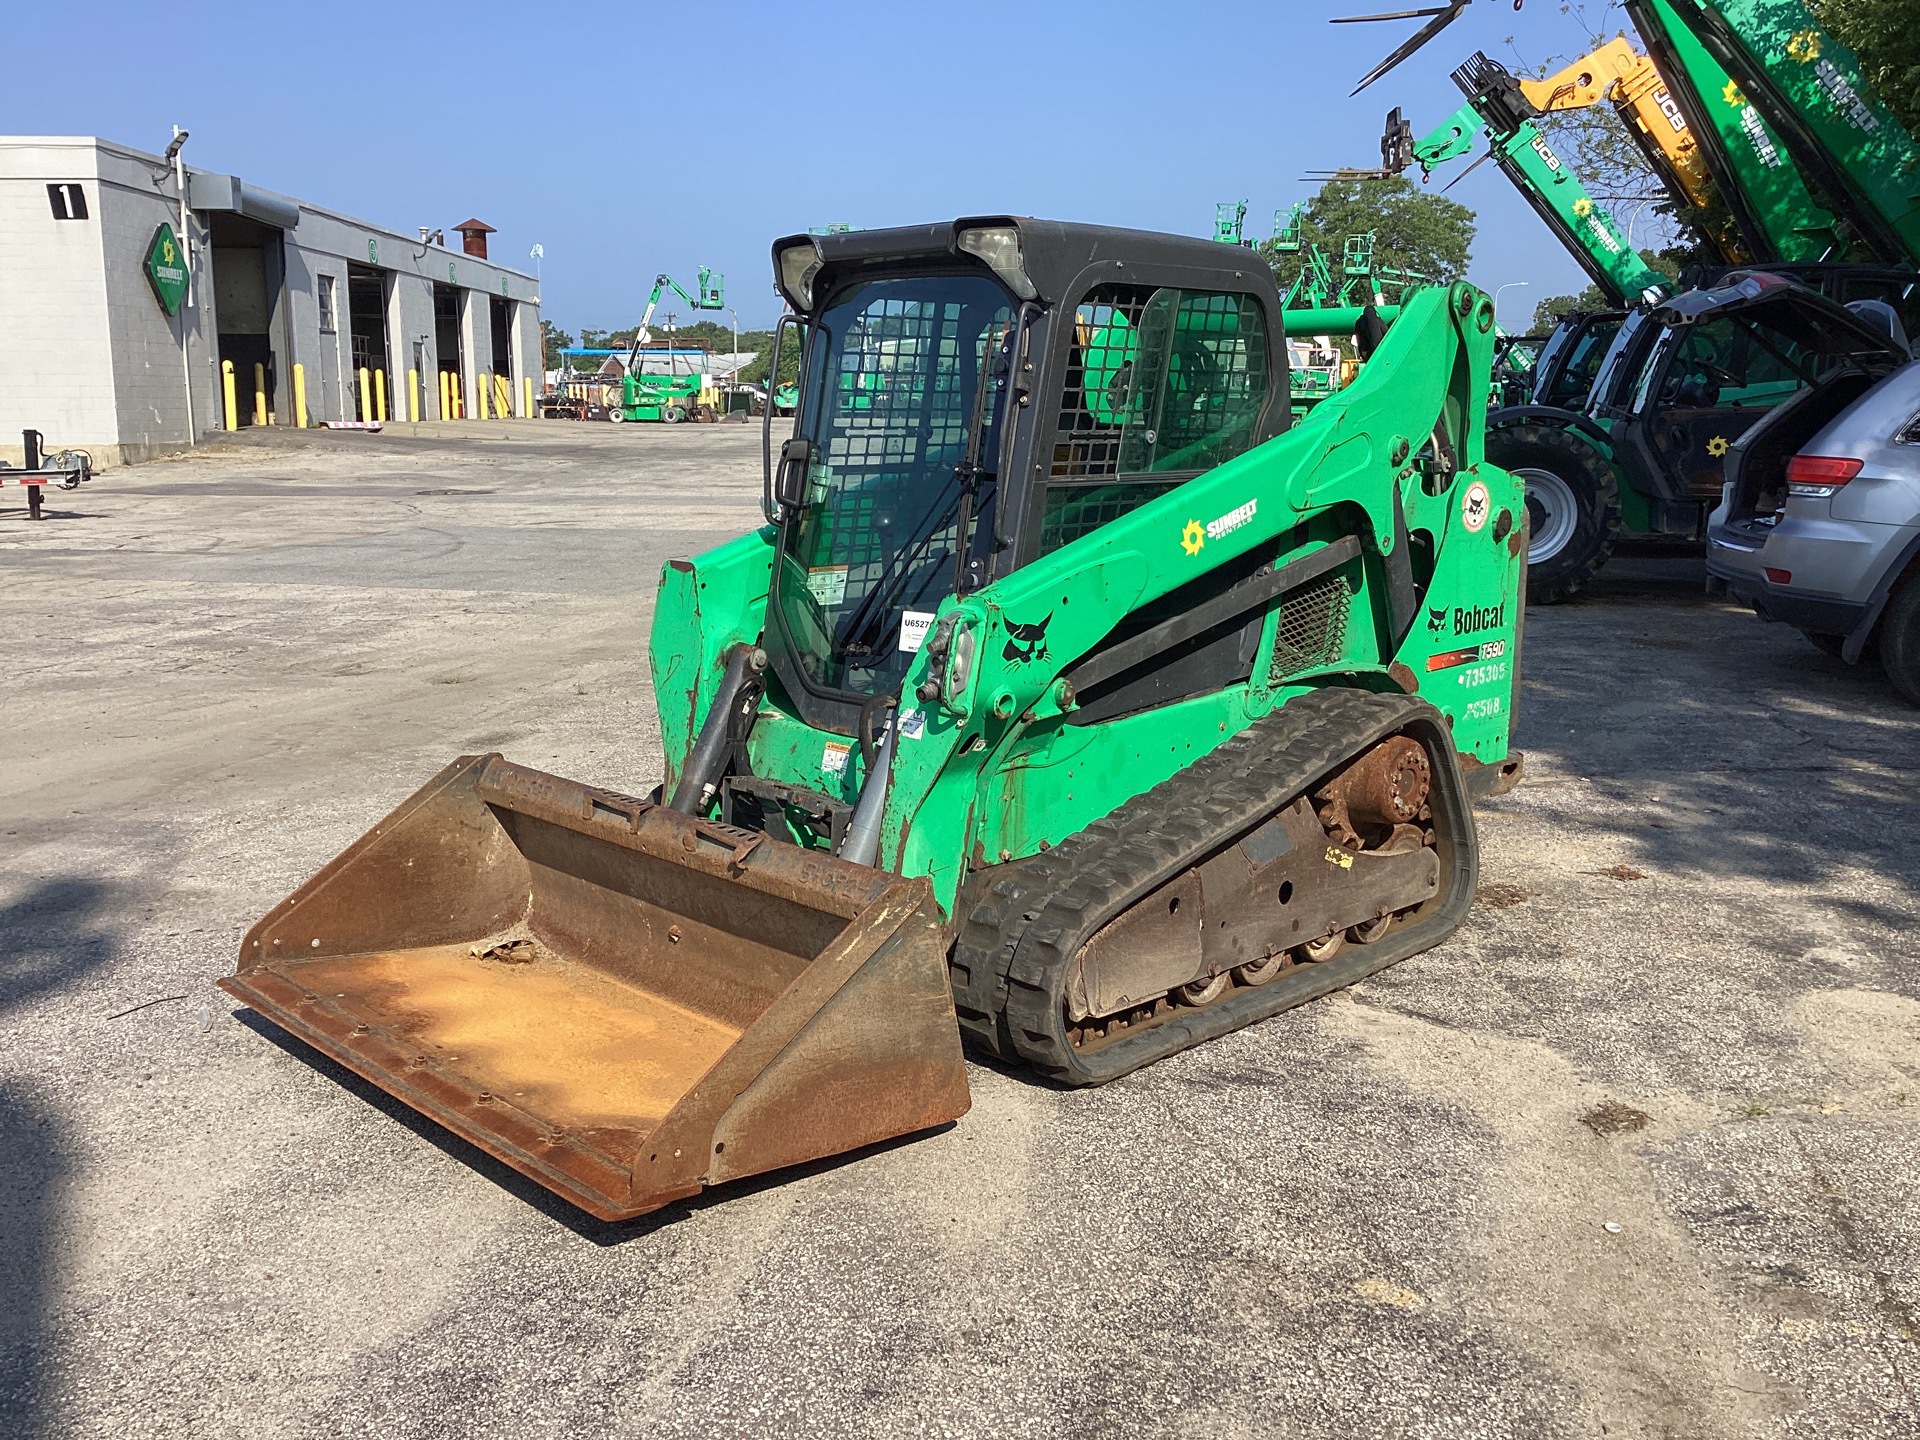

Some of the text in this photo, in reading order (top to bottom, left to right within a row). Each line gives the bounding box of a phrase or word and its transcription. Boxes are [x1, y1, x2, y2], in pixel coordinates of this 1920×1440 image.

[1652, 87, 1687, 132] JCB
[1740, 120, 1766, 165] RENTALS
[1741, 105, 1782, 169] SUNBELT
[1531, 137, 1561, 172] JCB
[58, 185, 74, 219] 1
[157, 265, 183, 281] SUNBELT
[1513, 350, 1532, 372] RENT
[1206, 498, 1258, 538] SUNBELT
[1215, 516, 1253, 541] RENTALS
[1453, 602, 1505, 636] Bobcat
[1481, 640, 1505, 660] T590
